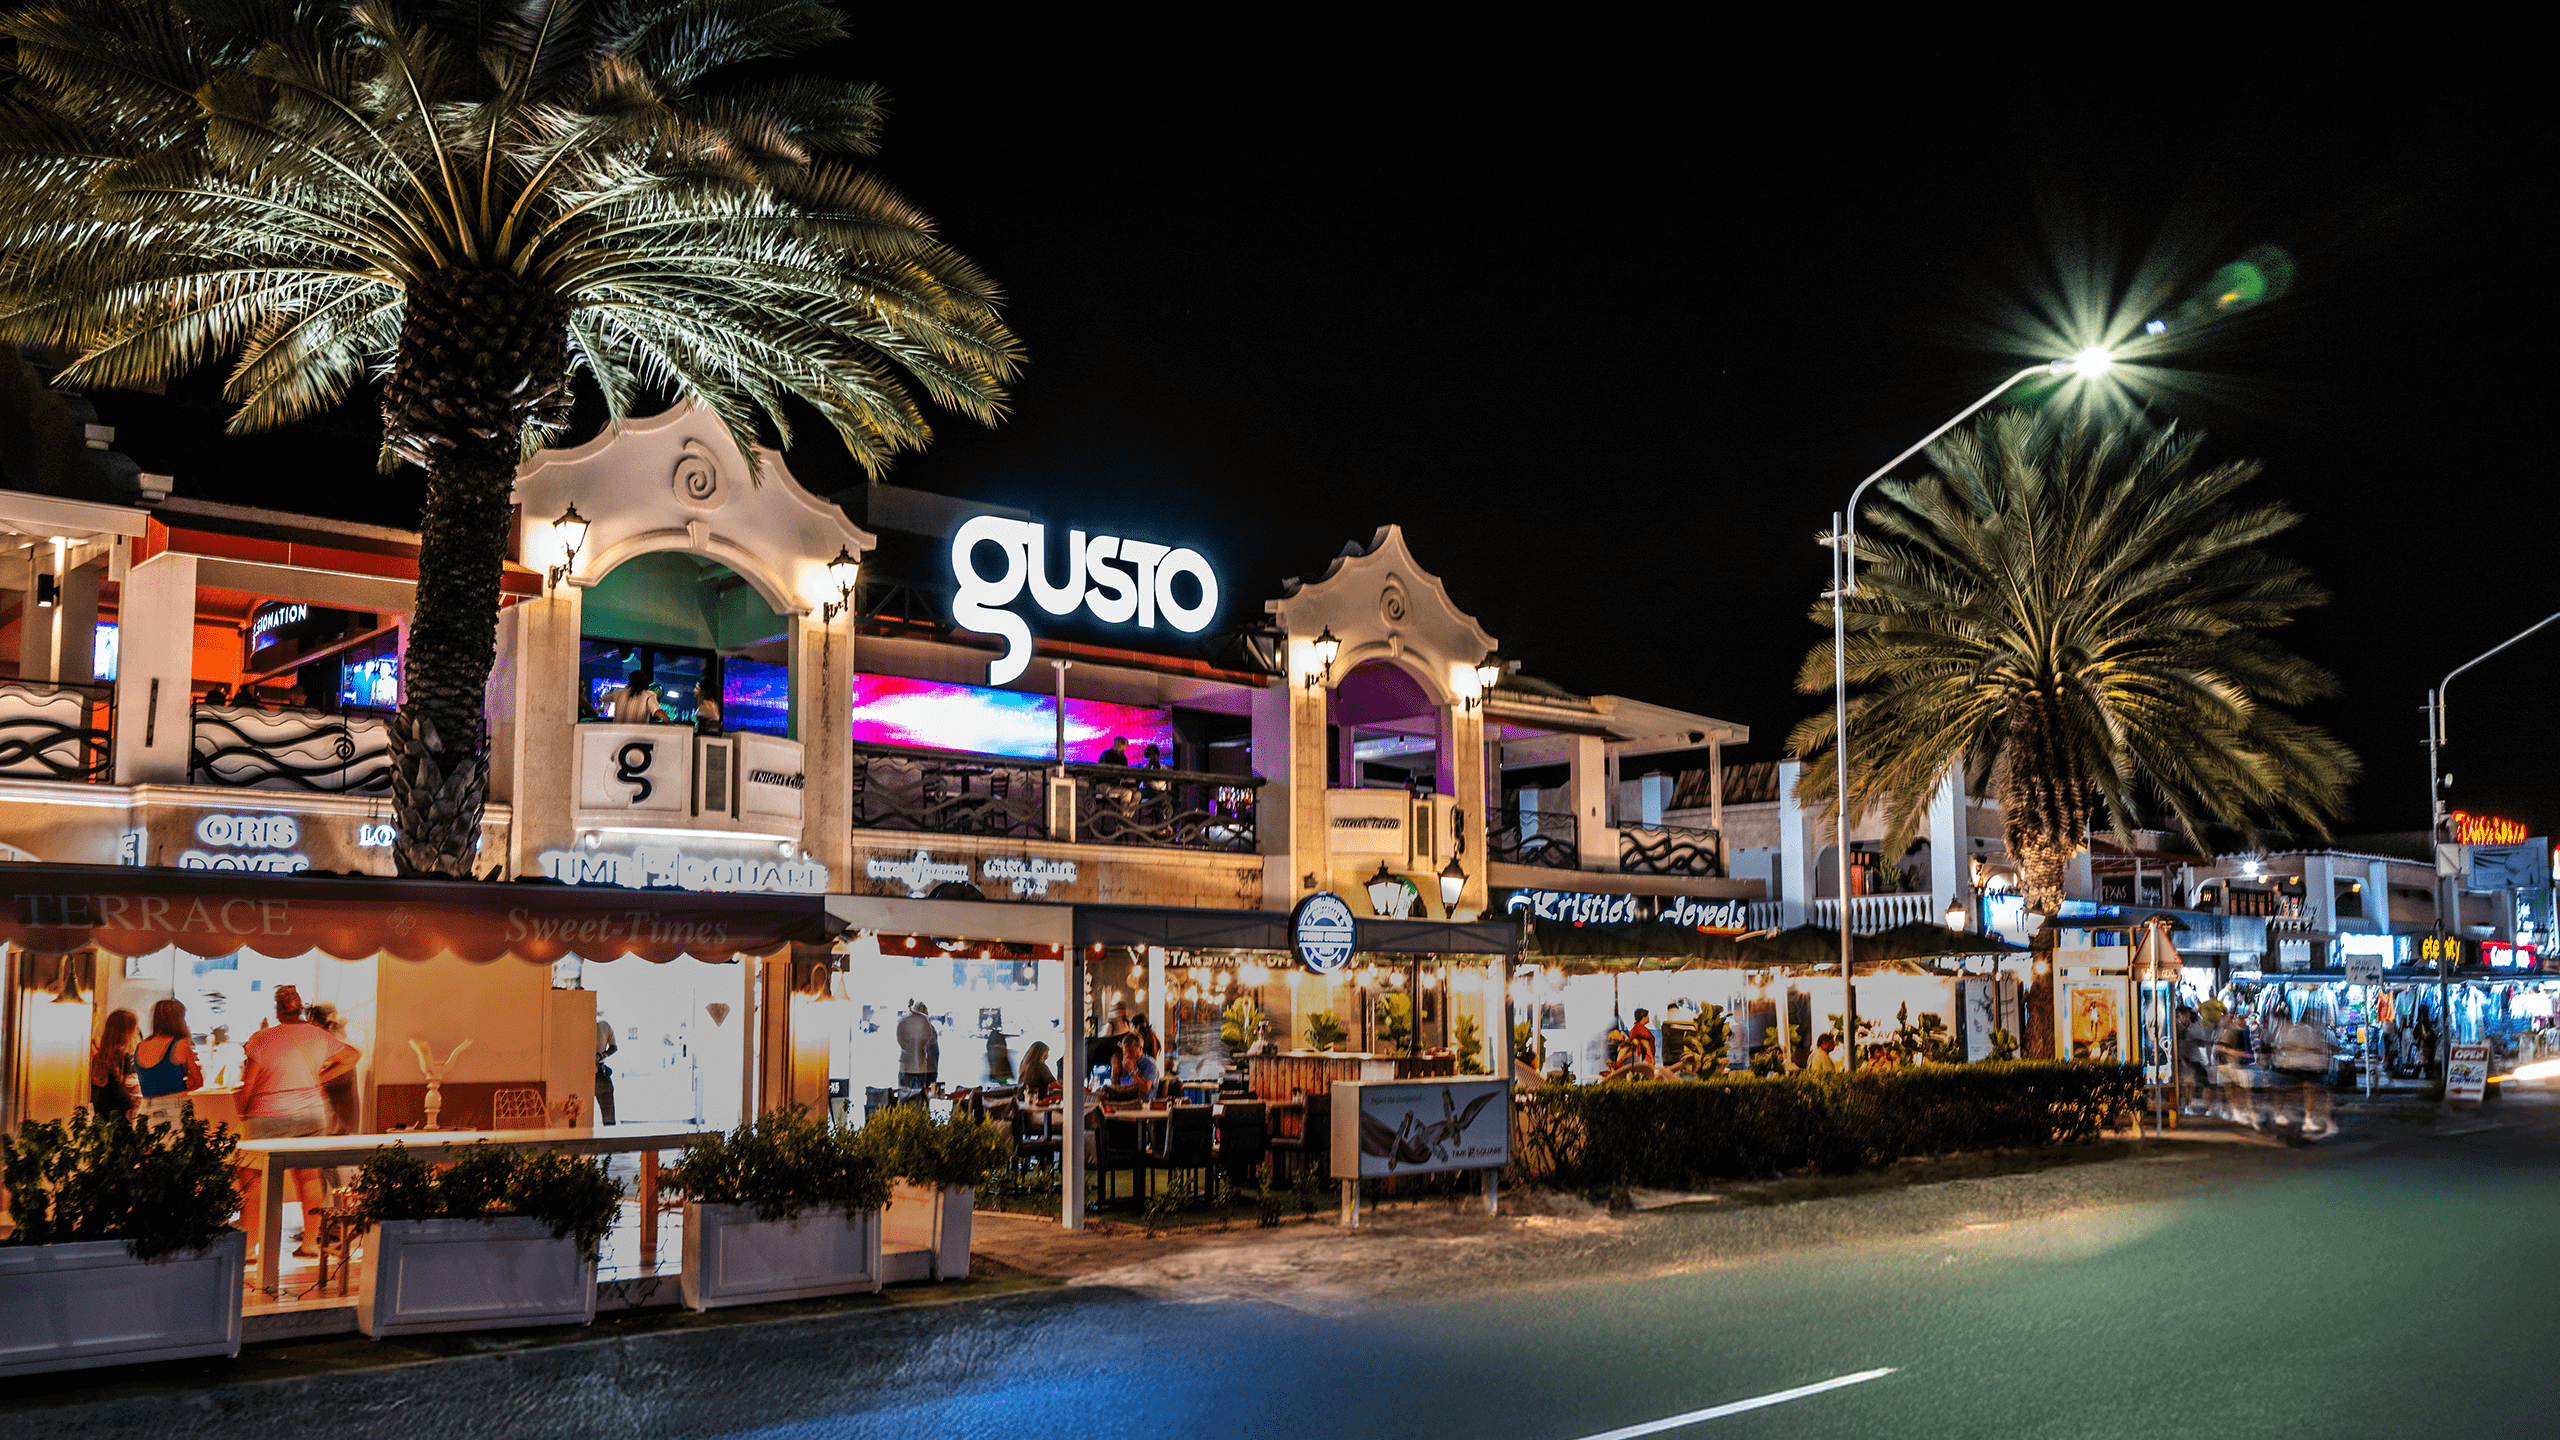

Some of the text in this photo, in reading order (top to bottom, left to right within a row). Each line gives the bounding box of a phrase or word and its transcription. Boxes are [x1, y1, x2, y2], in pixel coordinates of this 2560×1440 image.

[202, 817, 297, 846] ORIS
[684, 859, 828, 892] SQUARE
[14, 894, 292, 936] TERRACE
[504, 907, 728, 945] Sweet-Times
[1532, 891, 1747, 931] Kristie's Jewels
[2422, 935, 2461, 966] etenity
[2454, 1049, 2485, 1060] OPEN
